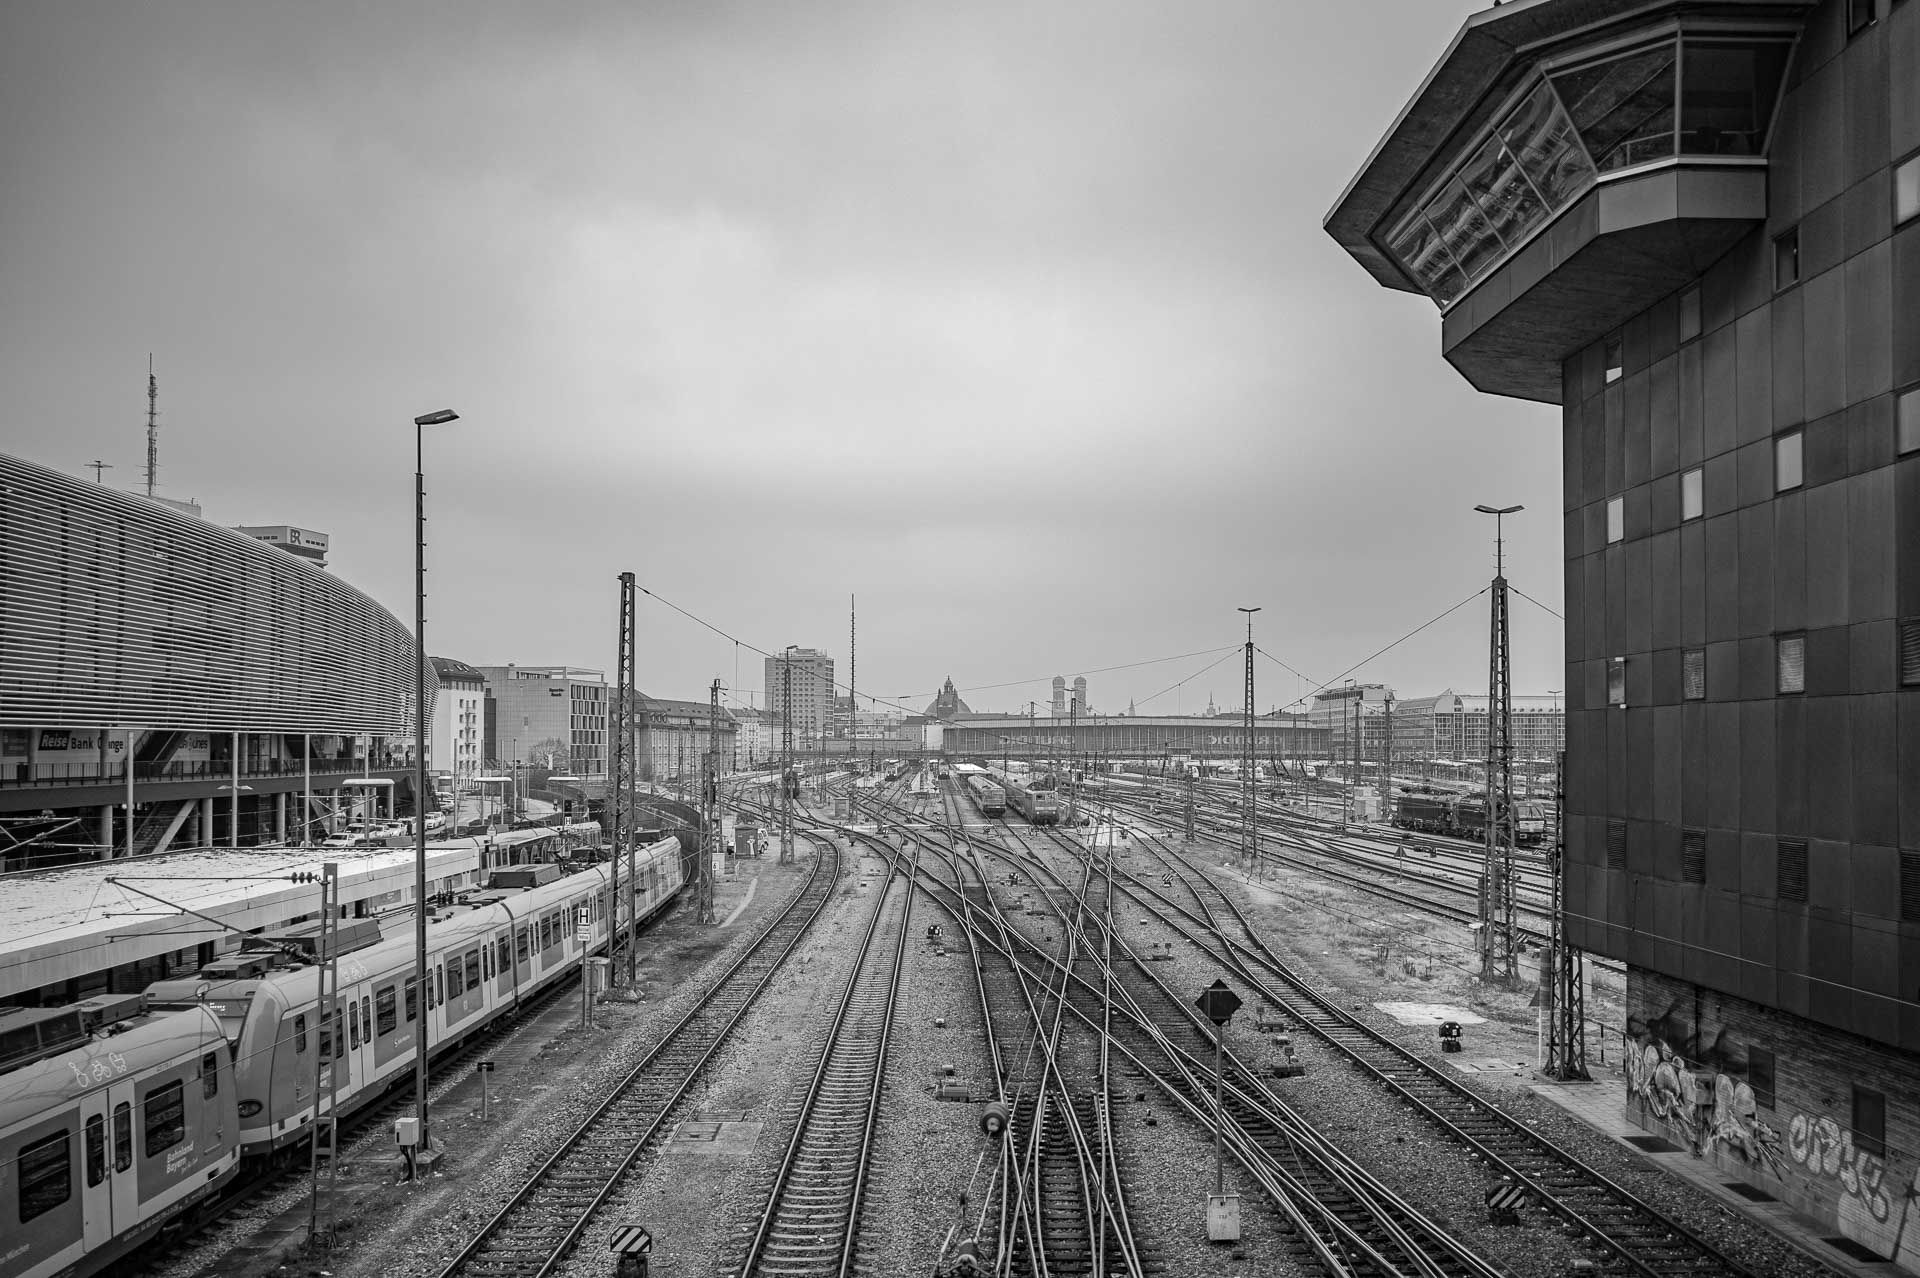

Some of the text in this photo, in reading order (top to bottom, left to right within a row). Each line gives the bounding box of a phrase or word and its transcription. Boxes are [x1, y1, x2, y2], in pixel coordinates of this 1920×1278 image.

[290, 528, 301, 545] BR
[41, 734, 124, 753] Reise Bank Cnge
[579, 908, 589, 924] H
